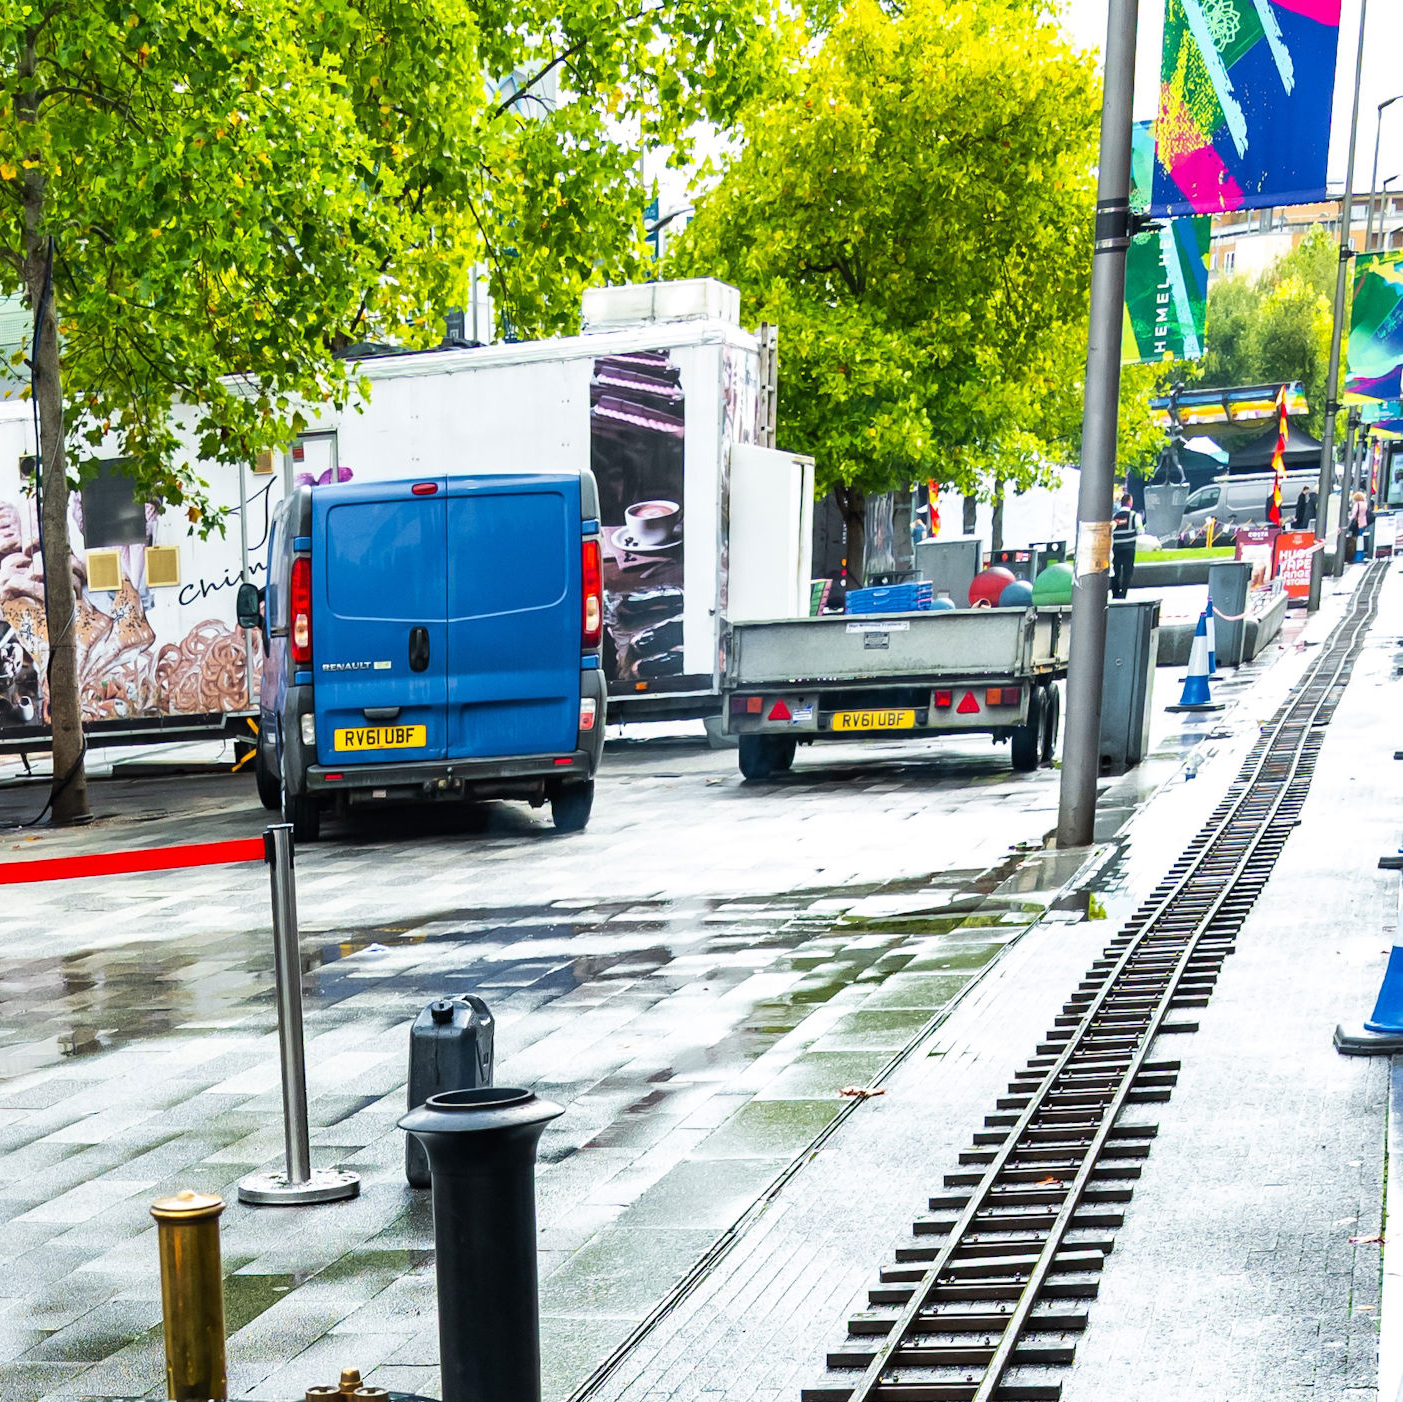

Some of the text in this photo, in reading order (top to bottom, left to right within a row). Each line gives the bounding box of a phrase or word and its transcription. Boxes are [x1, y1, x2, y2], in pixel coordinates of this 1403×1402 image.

[1154, 277, 1170, 354] HEMEL
[322, 661, 371, 672] RENAULT
[842, 712, 906, 727] RV61 UBF
[345, 727, 415, 747] RV61 UBF
